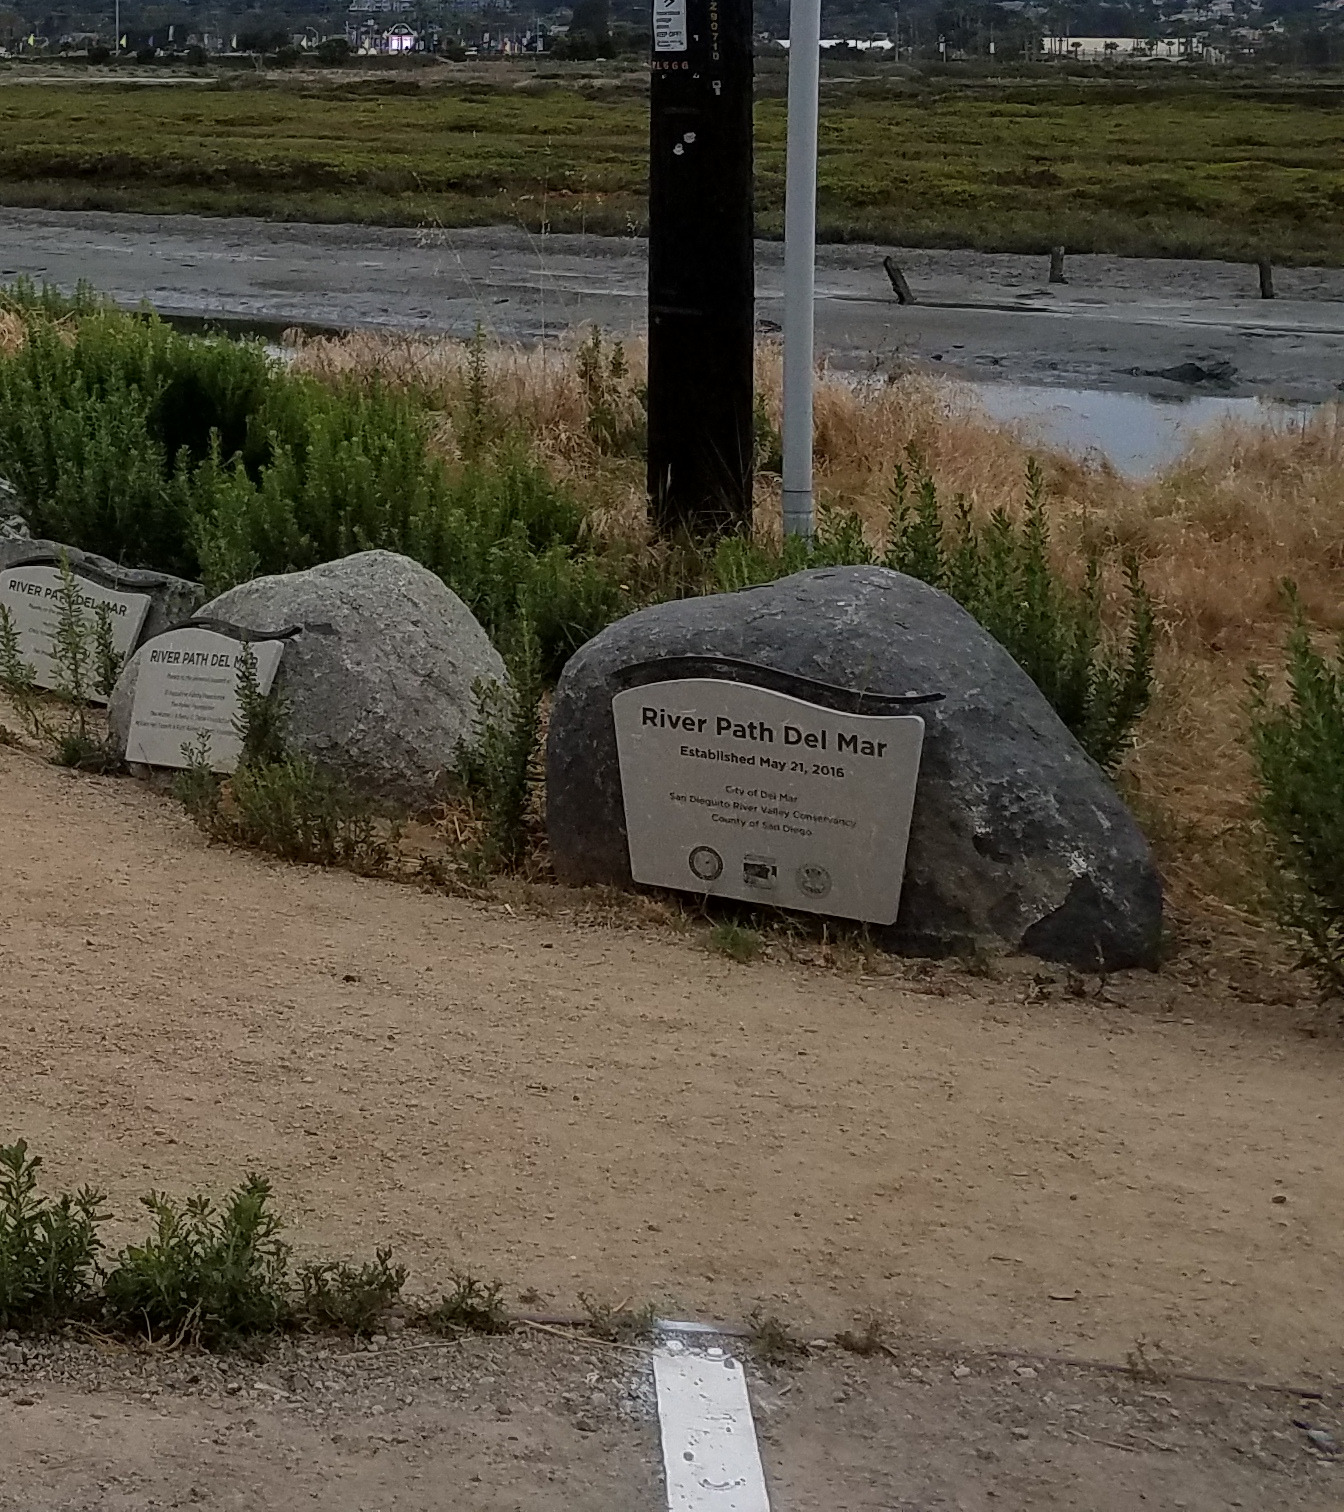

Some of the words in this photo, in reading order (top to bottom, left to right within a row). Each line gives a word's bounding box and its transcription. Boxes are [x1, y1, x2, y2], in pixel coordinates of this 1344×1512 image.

[8, 579, 42, 596] RIVER
[74, 594, 97, 610] DEL
[150, 650, 180, 664] RIVER
[182, 652, 209, 667] PATH
[210, 654, 231, 668] DEL
[641, 706, 707, 733] River
[716, 716, 774, 743] Path
[784, 725, 827, 750] Del
[837, 733, 888, 758] Mar
[680, 745, 755, 766] Established
[759, 756, 786, 772] May
[790, 760, 808, 775] 21,
[812, 764, 845, 778] 2016
[725, 785, 745, 796] City
[746, 789, 758, 797] of
[760, 790, 777, 801] Del
[779, 793, 798, 803] Mar
[669, 792, 686, 802] San
[689, 795, 731, 809] Dieguito
[733, 801, 757, 812] River
[761, 806, 790, 819] Valley
[792, 810, 857, 829] Conservancy
[711, 813, 746, 828] County
[749, 820, 759, 828] of
[762, 821, 780, 831] San
[782, 824, 812, 837] Diego
